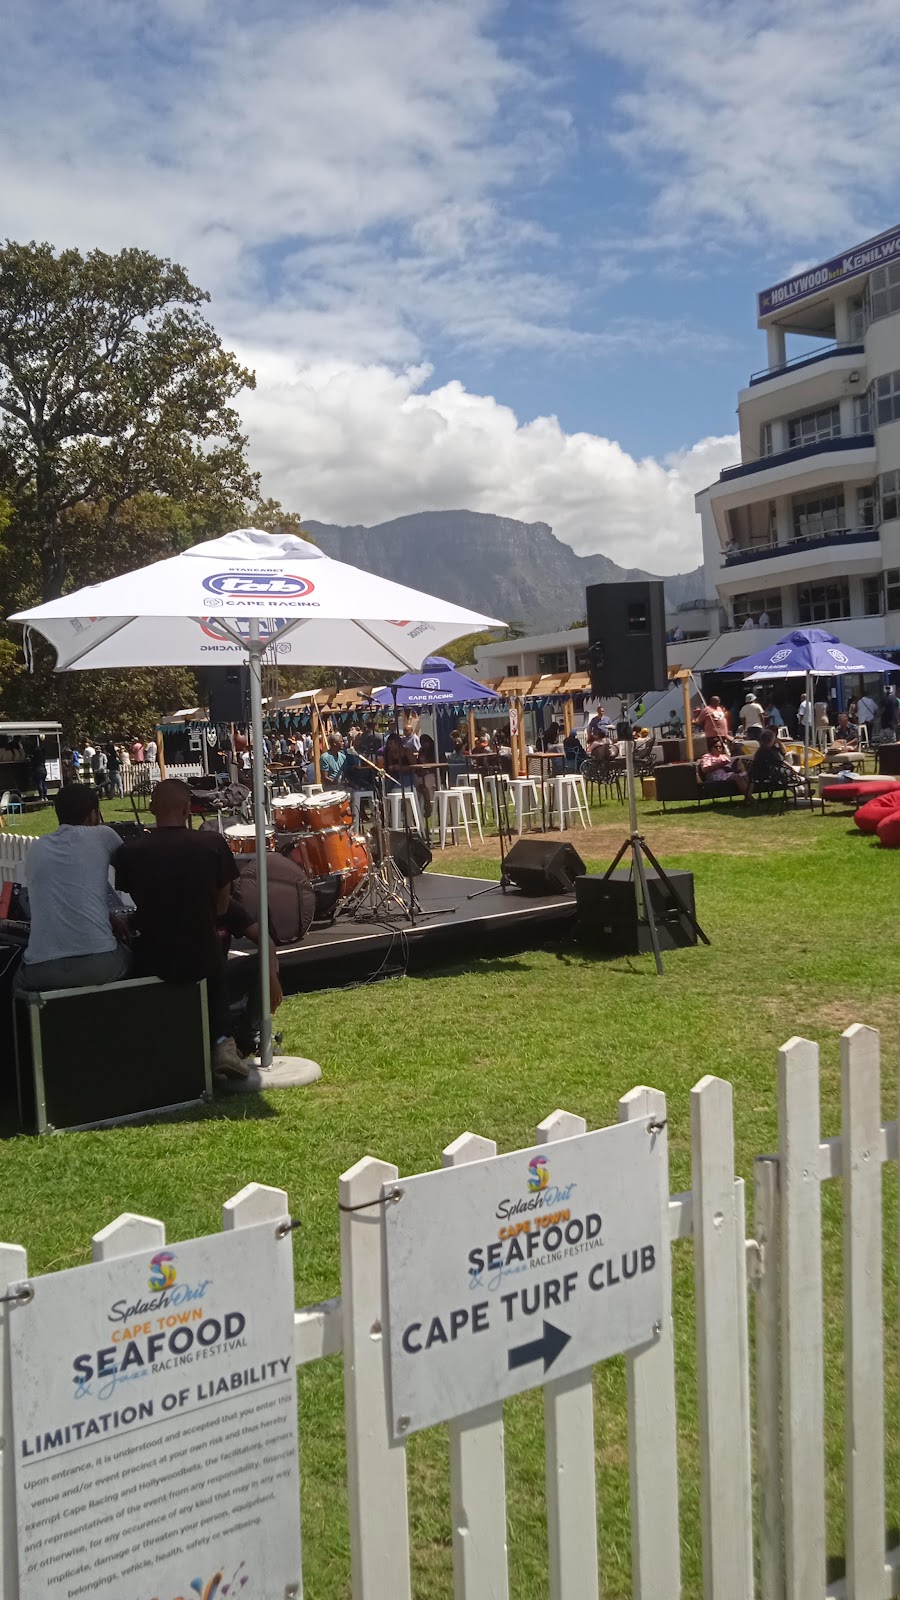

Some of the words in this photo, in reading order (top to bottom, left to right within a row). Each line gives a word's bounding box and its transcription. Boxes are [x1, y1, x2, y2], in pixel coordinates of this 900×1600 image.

[220, 578, 301, 592] tab
[468, 1213, 602, 1276] SEAFOOD
[498, 1220, 532, 1240] CAPE
[534, 1208, 570, 1228] TOWN
[530, 1251, 562, 1269] RACING
[564, 1237, 604, 1258] FESTIVAL
[111, 1321, 152, 1344] CAPE
[158, 1308, 203, 1331] TOWN
[401, 1301, 490, 1355] CAPE
[500, 1272, 579, 1322] TURF
[588, 1245, 656, 1292] CLUB
[72, 1311, 246, 1384] SEAFOOD
[152, 1354, 193, 1374] RACING
[196, 1338, 248, 1361] FESTIVAL
[21, 1399, 154, 1458] LIMITATION
[161, 1388, 190, 1411] OF
[197, 1356, 292, 1401] LIABILITY
[23, 1476, 49, 1490] Upon
[51, 1462, 94, 1480] entrance,
[104, 1455, 111, 1463] is
[113, 1437, 162, 1459] understood
[165, 1430, 180, 1442] and
[182, 1416, 220, 1436] accepted
[221, 1411, 238, 1422] that
[239, 1407, 254, 1419] you
[256, 1400, 277, 1411] enter
[278, 1394, 292, 1404] this
[31, 1493, 59, 1508] venue
[61, 1481, 93, 1498] and/or
[95, 1471, 119, 1485] event
[122, 1459, 157, 1478] precinct
[159, 1456, 167, 1464] at
[169, 1448, 188, 1461] your
[189, 1441, 207, 1453] own
[209, 1435, 223, 1446] risk
[225, 1430, 240, 1440] and
[242, 1424, 259, 1435] thus
[260, 1415, 287, 1429] hereby
[24, 1540, 42, 1552] and
[44, 1514, 114, 1545] representatives
[116, 1508, 125, 1518] of
[127, 1503, 141, 1514] the
[143, 1494, 167, 1509] event
[168, 1487, 189, 1499] from
[190, 1481, 205, 1492] any
[262, 1448, 295, 1464] financial
[25, 1513, 61, 1531] exempt
[62, 1503, 87, 1518] Cape
[88, 1492, 118, 1509] Racing
[120, 1485, 137, 1497] and
[205, 1456, 218, 1467] the
[265, 1432, 293, 1446] owners
[27, 1562, 38, 1573] or
[89, 1539, 102, 1549] for
[104, 1531, 120, 1543] any
[168, 1509, 177, 1518] of
[178, 1503, 194, 1515] any
[195, 1496, 212, 1509] kind
[214, 1489, 230, 1501] that
[232, 1483, 250, 1494] may
[251, 1480, 259, 1488] in
[260, 1475, 274, 1485] any
[275, 1468, 292, 1479] way
[93, 1548, 130, 1567] damage
[131, 1544, 141, 1553] or
[142, 1530, 179, 1548] threaten
[180, 1520, 199, 1535] your
[186, 1534, 211, 1551] safety
[212, 1531, 221, 1540] or
